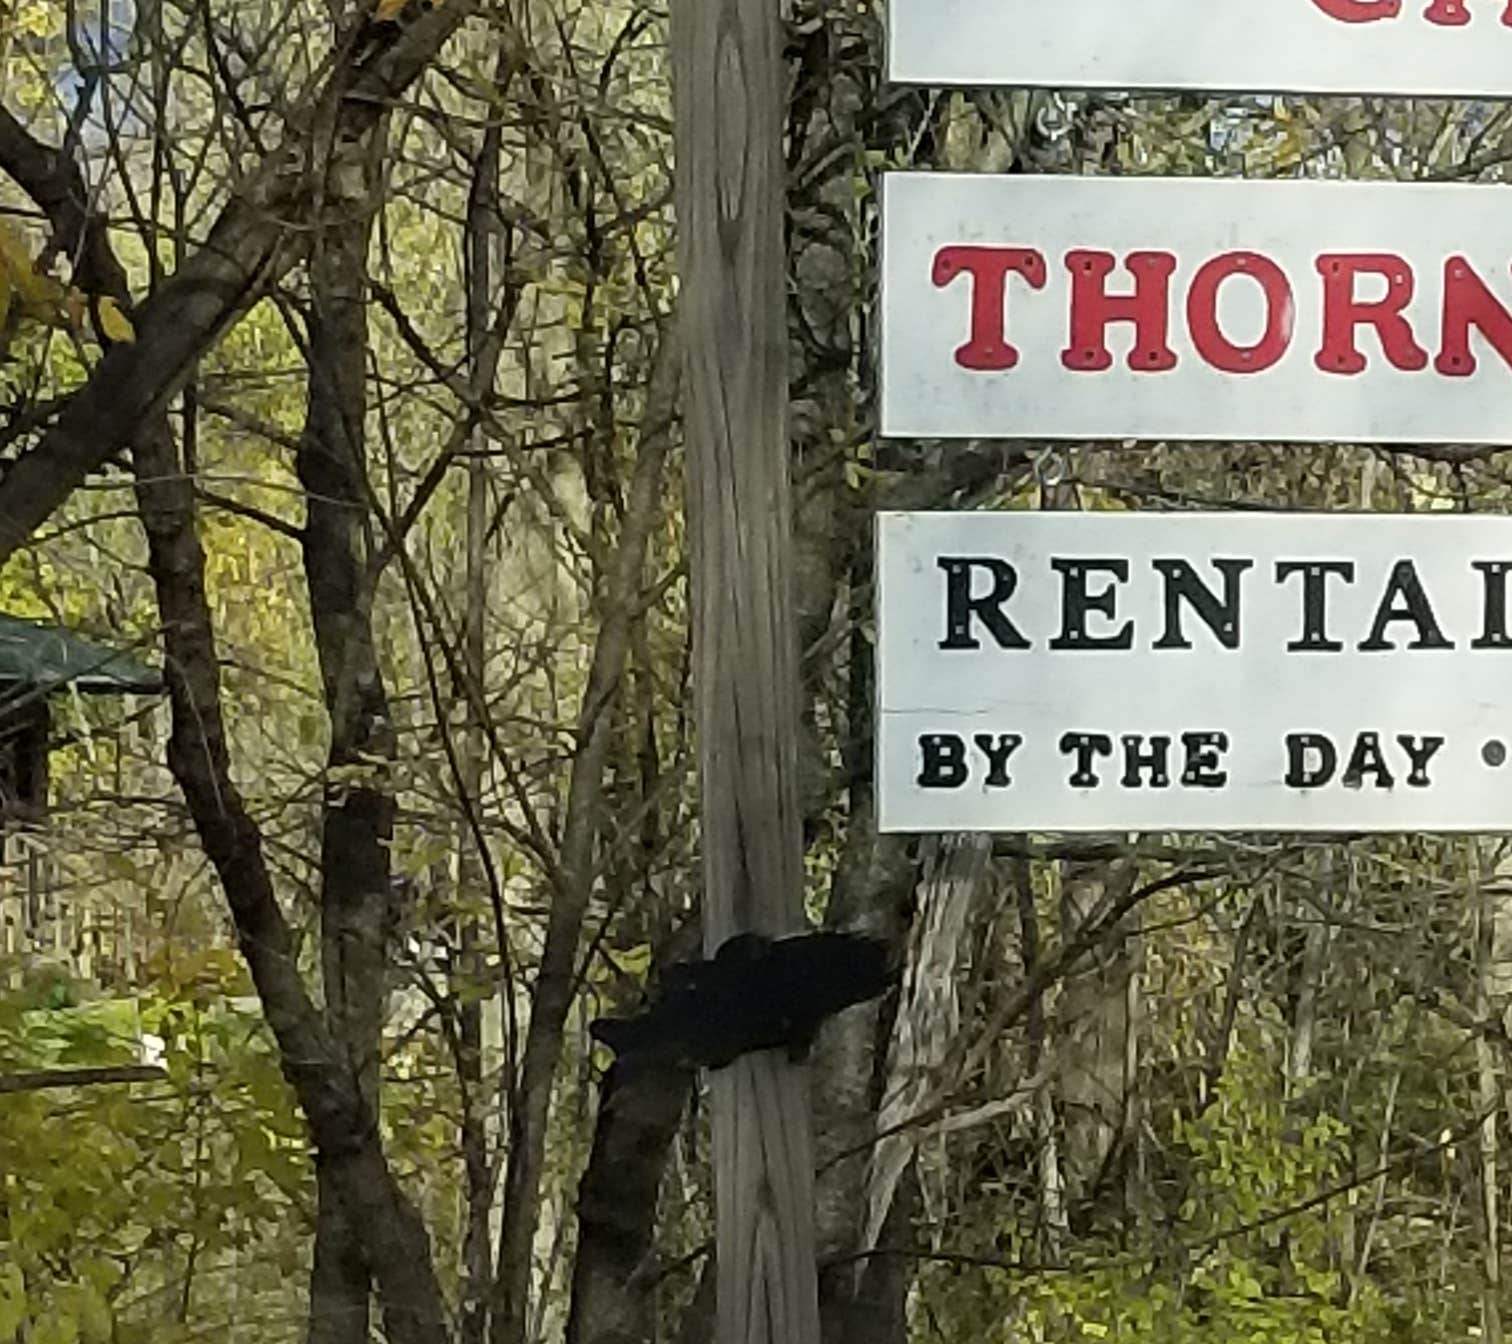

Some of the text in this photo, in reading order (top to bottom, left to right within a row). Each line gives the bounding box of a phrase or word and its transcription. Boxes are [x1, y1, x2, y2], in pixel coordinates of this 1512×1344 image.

[916, 732, 1022, 789] BY
[1059, 731, 1229, 789] THE
[1284, 731, 1445, 789] DAY
